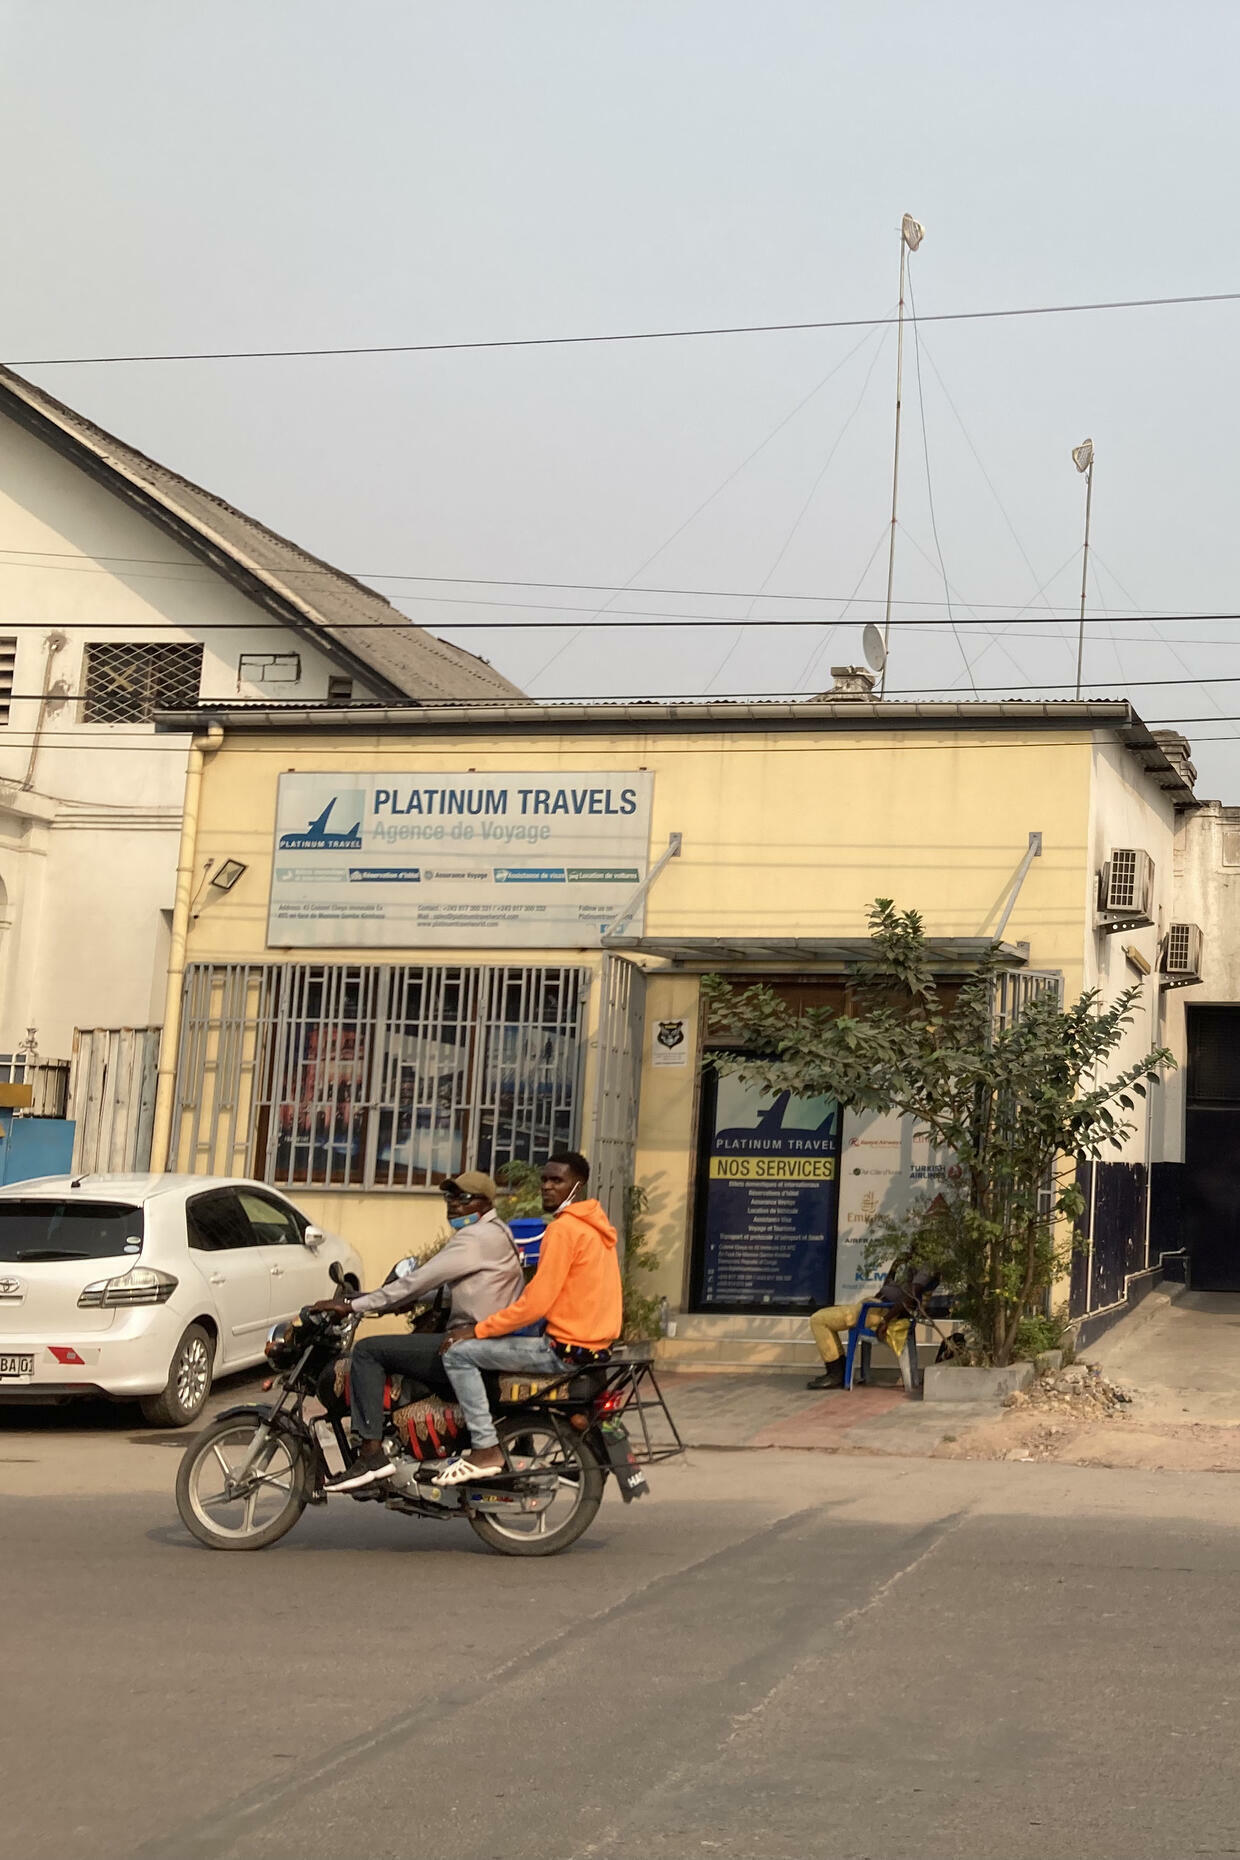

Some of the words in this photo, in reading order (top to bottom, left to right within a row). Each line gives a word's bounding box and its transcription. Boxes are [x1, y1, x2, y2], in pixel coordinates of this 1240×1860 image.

[374, 788, 508, 815] PLATINUM
[517, 788, 638, 815] TRAVELS
[372, 821, 445, 845] Agence
[451, 821, 475, 840] de
[480, 821, 551, 845] Voyage
[279, 840, 325, 848] PLATINUM
[328, 840, 362, 849] TRAVEL
[716, 1139, 782, 1150] PLATINUM
[788, 1140, 836, 1150] TRAVEL
[717, 1159, 750, 1177] NOS
[755, 1160, 833, 1177] SERVICES
[0, 1358, 16, 1372] BA
